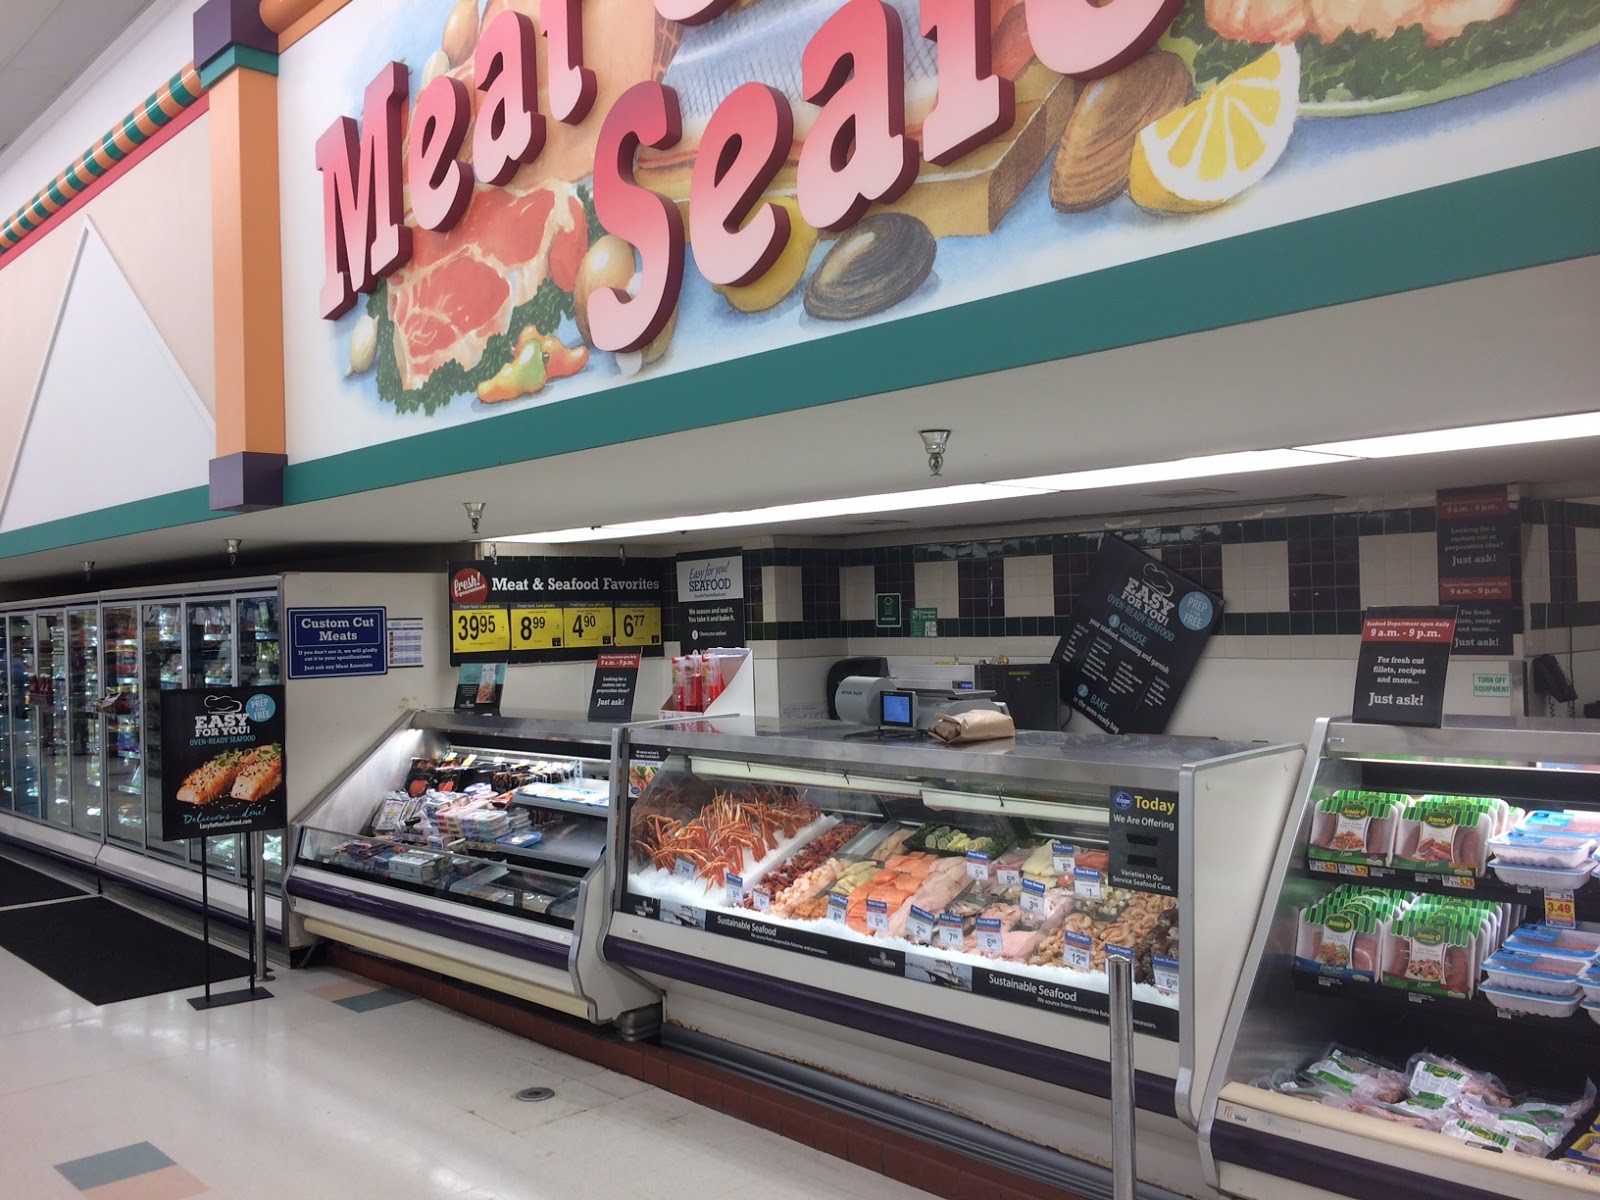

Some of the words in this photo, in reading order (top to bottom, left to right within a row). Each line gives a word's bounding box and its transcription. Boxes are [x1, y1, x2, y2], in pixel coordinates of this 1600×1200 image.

[1452, 556, 1472, 566] Just
[1474, 554, 1496, 563] ask!
[689, 568, 705, 581] Easy
[492, 577, 529, 591] Meat
[532, 577, 544, 591] &
[548, 576, 599, 590] Seafood
[603, 577, 660, 590] Favorites
[689, 578, 731, 592] SEAFOOD
[1124, 577, 1175, 615] EASY
[1120, 590, 1141, 610] FOR
[1143, 604, 1170, 626] YOU!
[1187, 598, 1208, 612] PREP
[301, 618, 350, 629] Custom
[352, 618, 374, 627] Cut
[1107, 594, 1146, 624] OVEN-READY
[1146, 619, 1175, 642] SEAFOOD
[1183, 613, 1203, 628] FREE
[319, 631, 358, 641] Meats
[1119, 622, 1148, 646] CHOOSE
[1409, 628, 1415, 636] 9
[1416, 630, 1441, 638] p.m.
[1089, 618, 1100, 630] your
[1100, 624, 1119, 641] seafood,
[1119, 636, 1142, 657] seasoning
[1141, 650, 1152, 662] and
[1151, 657, 1170, 675] garnish
[1454, 638, 1474, 648] Just
[1373, 666, 1396, 674] fillets,
[1398, 667, 1426, 675] recipes
[251, 699, 268, 708] PREP
[597, 698, 610, 706] Just
[1090, 695, 1109, 713] BAKE
[1368, 692, 1393, 706] Just
[1396, 694, 1424, 706] ask!
[195, 714, 249, 729] EASY
[254, 710, 270, 720] FREE
[1078, 698, 1086, 708] the
[1110, 722, 1120, 734] bag
[195, 728, 219, 737] FOR
[221, 726, 250, 736] YOU!
[189, 736, 227, 746] OVEN-READY
[229, 734, 256, 744] SEAFOOD
[1134, 796, 1175, 815] Today
[1113, 814, 1125, 823] We
[1126, 816, 1140, 825] Are
[1141, 817, 1175, 831] Offering
[1121, 870, 1145, 879] Varieties
[1146, 872, 1151, 880] in
[1112, 875, 1132, 885] Service
[1133, 879, 1156, 888] Seafood
[1157, 882, 1172, 891] Case.
[1547, 902, 1571, 913] 3.49
[717, 915, 750, 931] Sustainable
[751, 922, 777, 936] Seafood
[988, 973, 1037, 994] Sustainable
[1038, 984, 1078, 1003] Seafood
[1044, 999, 1060, 1007] source
[1060, 1001, 1073, 1010] from
[1073, 1004, 1099, 1016] responsible
[1133, 1018, 1157, 1029] rocessors.
